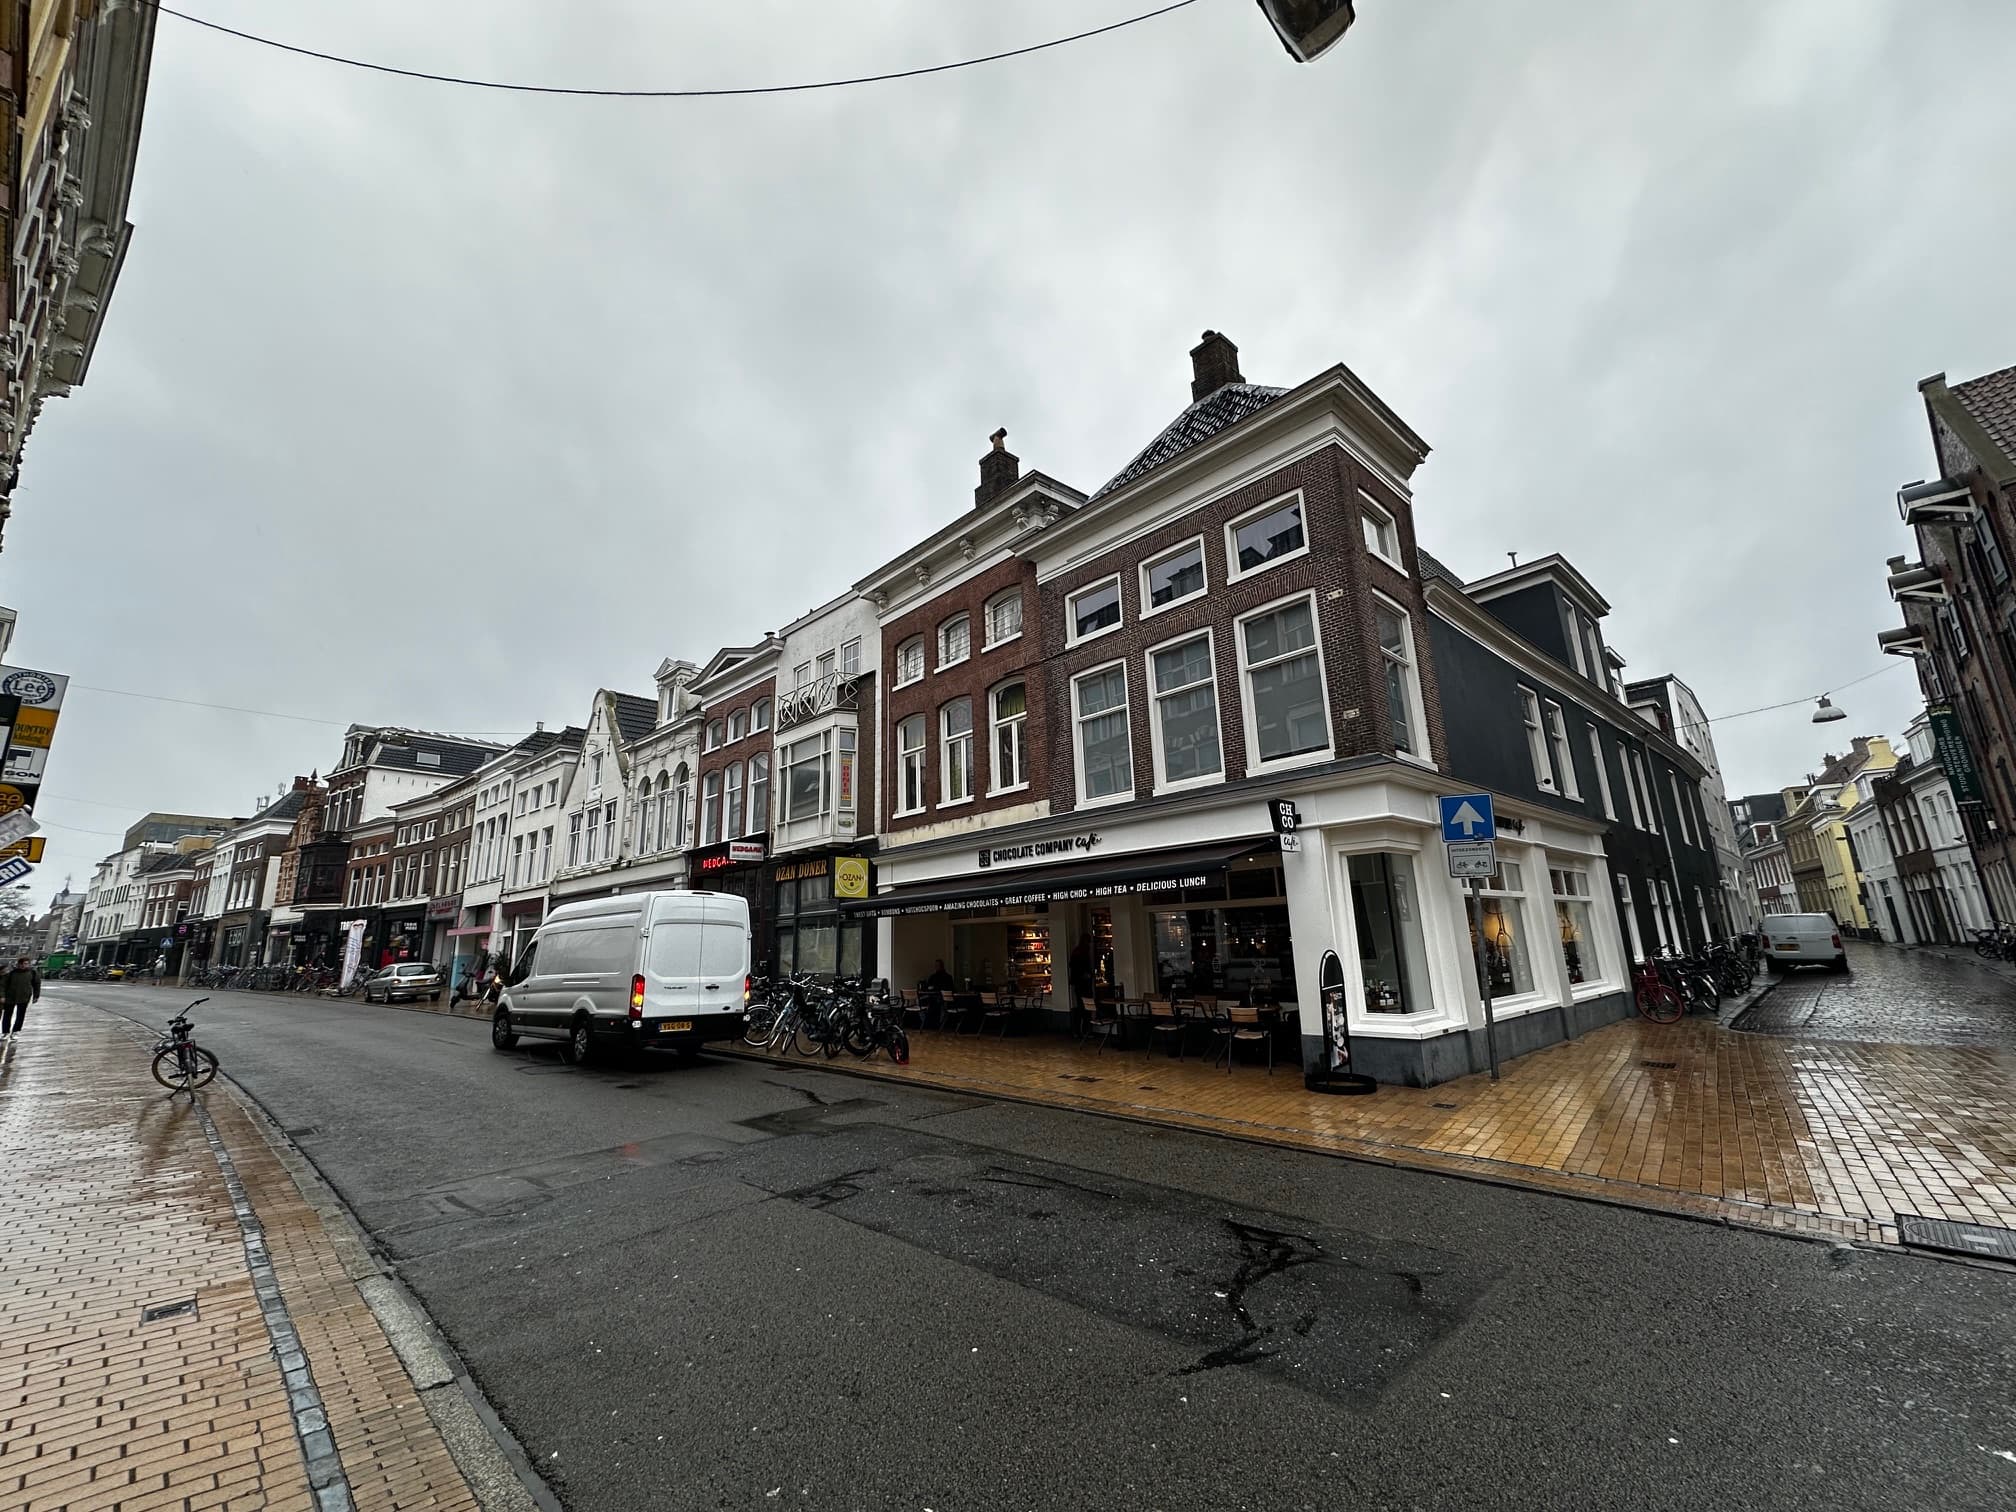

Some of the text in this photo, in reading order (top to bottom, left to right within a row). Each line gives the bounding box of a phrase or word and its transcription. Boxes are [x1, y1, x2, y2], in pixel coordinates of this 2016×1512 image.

[12, 680, 46, 695] Lee
[1280, 803, 1293, 816] CH
[1282, 816, 1294, 828] CO
[993, 845, 1034, 862] CHOCOLATE
[1035, 839, 1073, 856] COMPANY
[703, 857, 737, 868] NEDGA
[0, 861, 26, 884] RIJ
[776, 864, 796, 881] OZAN
[943, 901, 964, 910] AMAZING
[966, 898, 999, 909] CHOCOLATES
[1005, 895, 1022, 905] GREAT
[1024, 893, 1046, 903] COFFEE
[1052, 890, 1069, 900] HIGH
[1070, 889, 1088, 899] CHOC
[1095, 886, 1112, 896] HIGH
[1113, 885, 1127, 894] TEA
[1136, 879, 1177, 892] DELICIOUS
[1179, 876, 1206, 888] LUNCH
